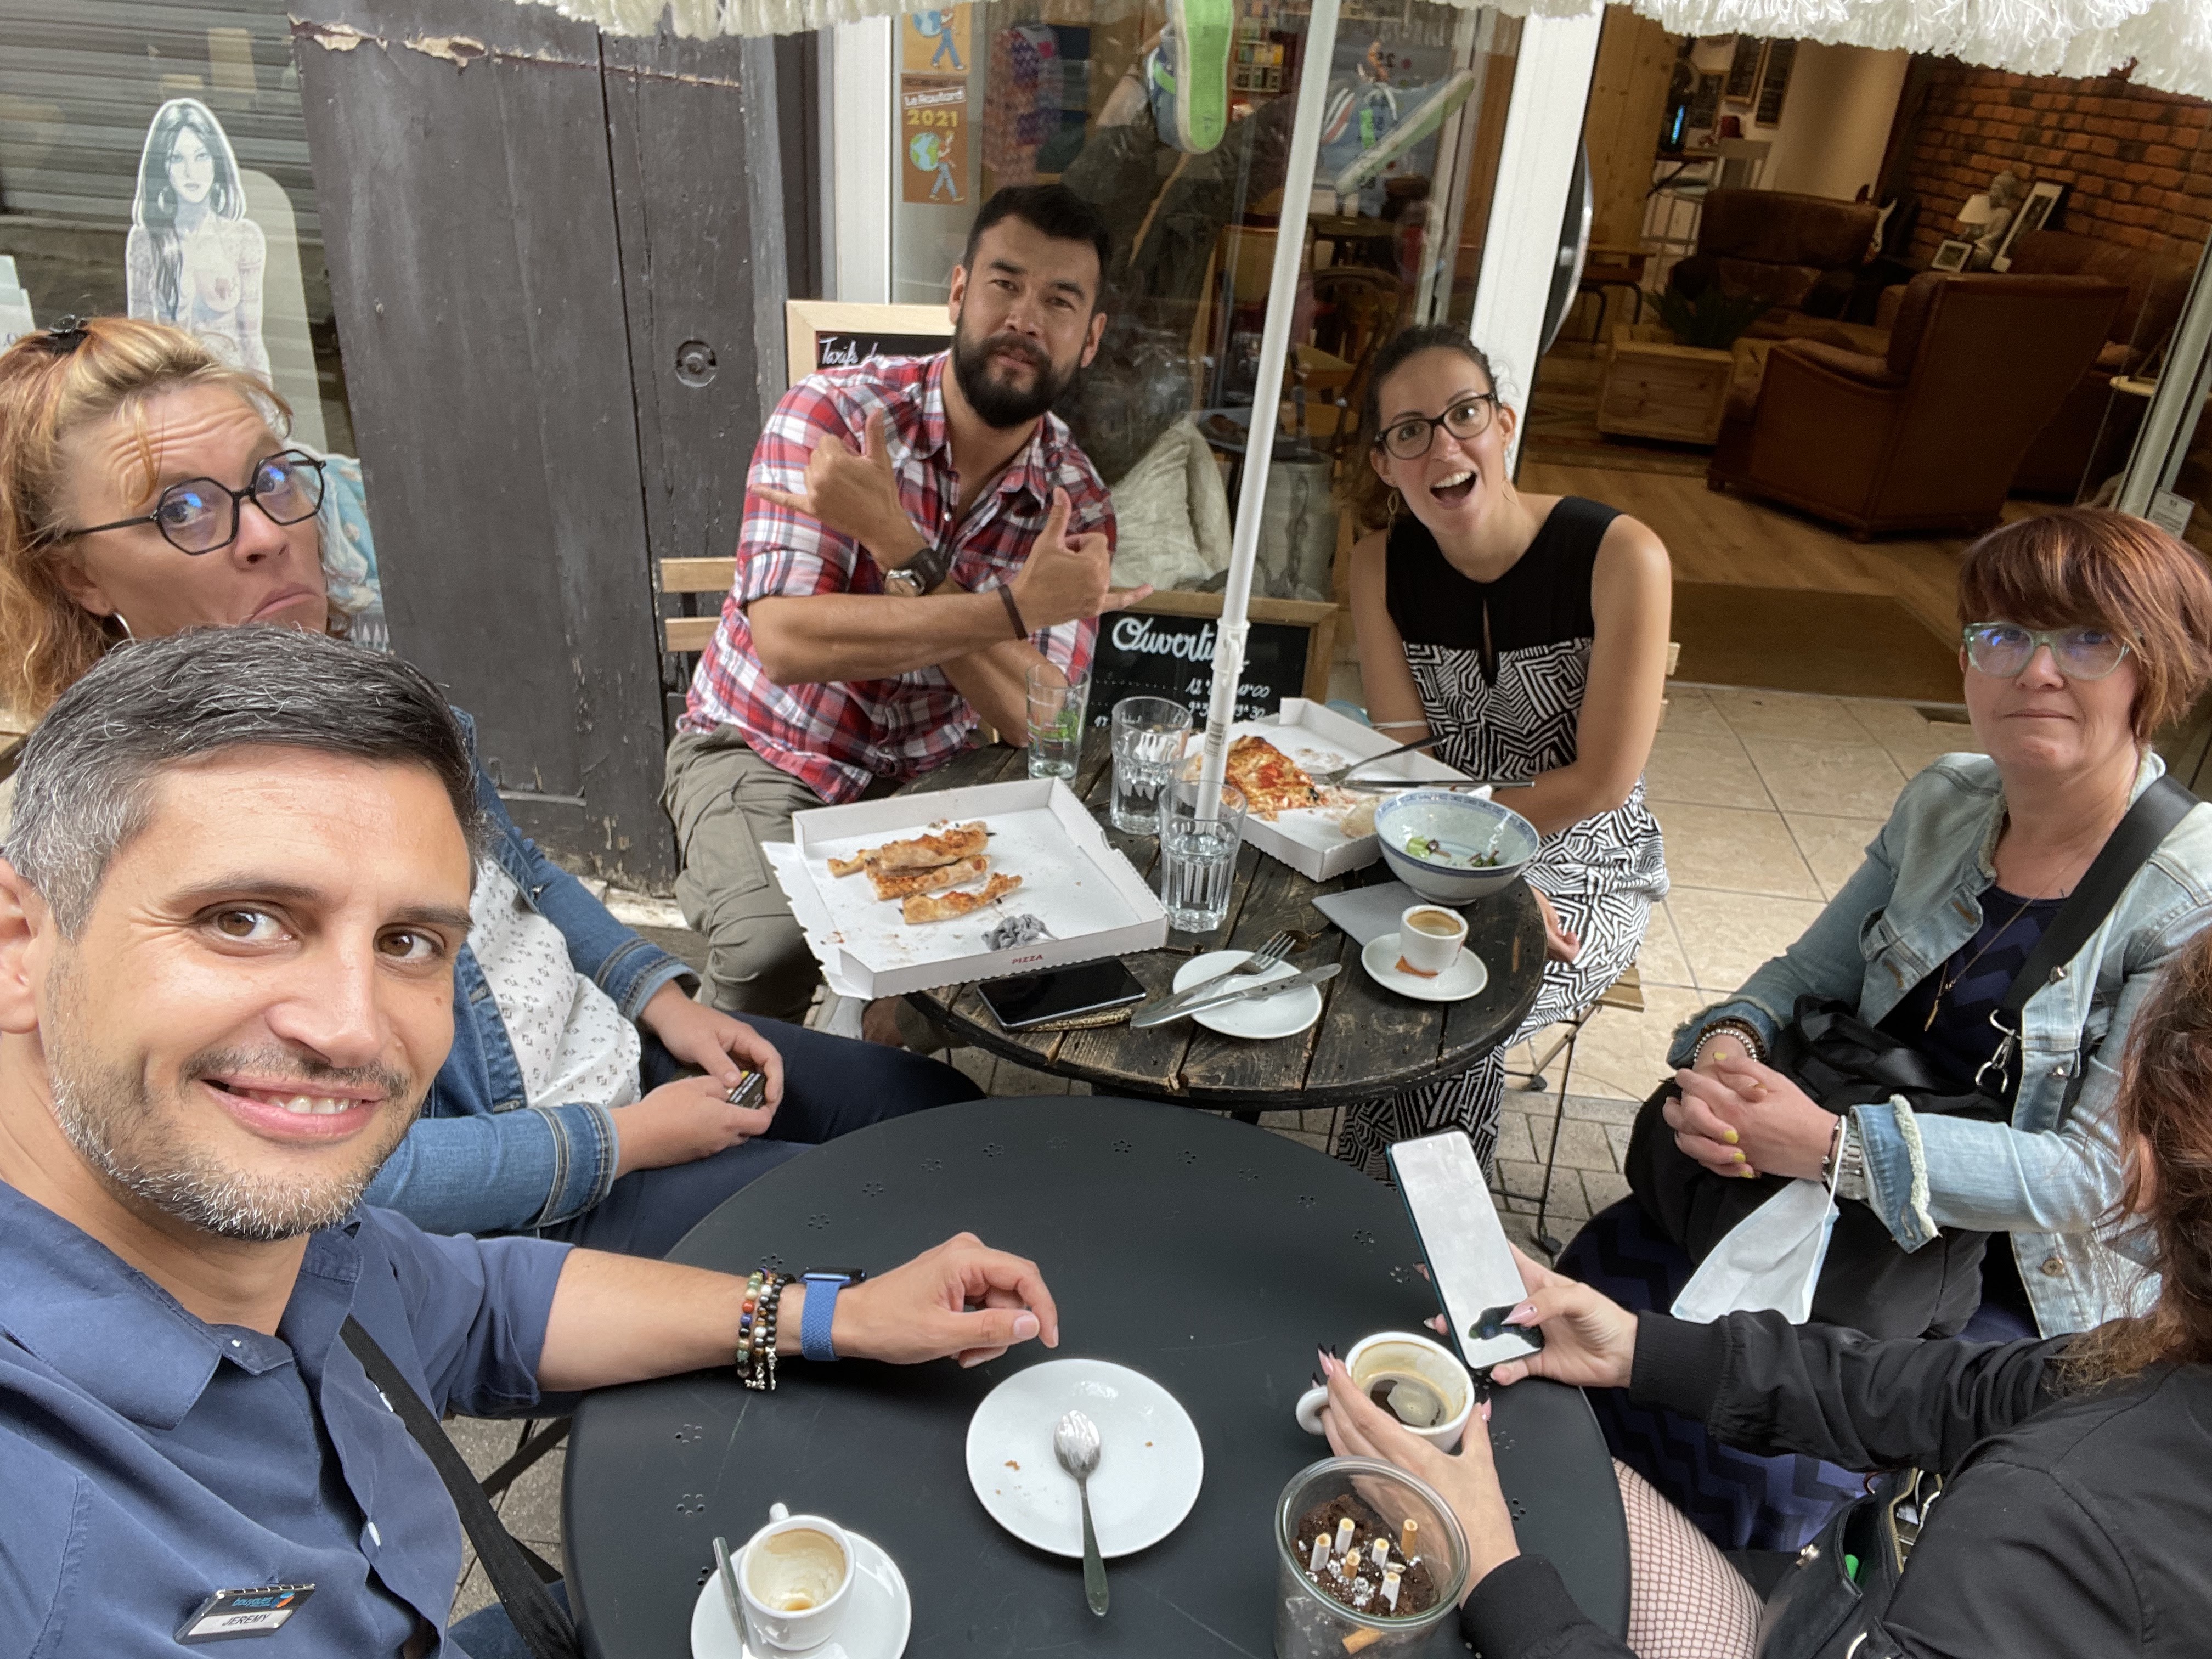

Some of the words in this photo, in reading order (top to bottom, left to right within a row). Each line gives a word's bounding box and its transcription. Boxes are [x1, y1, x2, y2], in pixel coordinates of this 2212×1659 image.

[906, 109, 959, 127] 2021
[1012, 955, 1043, 964] PIZZA
[222, 1613, 270, 1626] JEREMY
